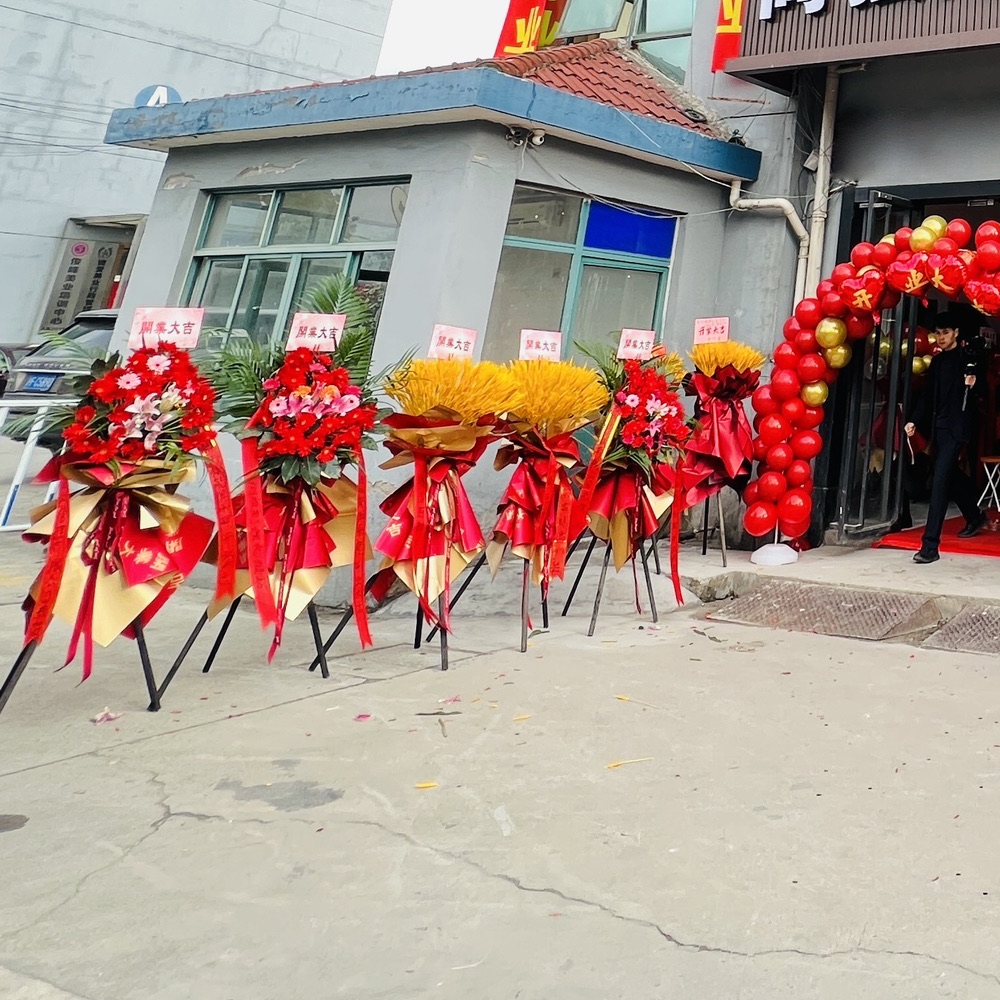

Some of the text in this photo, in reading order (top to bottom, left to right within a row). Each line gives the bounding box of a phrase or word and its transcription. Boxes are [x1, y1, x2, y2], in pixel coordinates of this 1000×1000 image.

[138, 320, 196, 336] 開業大吉
[295, 325, 339, 340] 開業大吉
